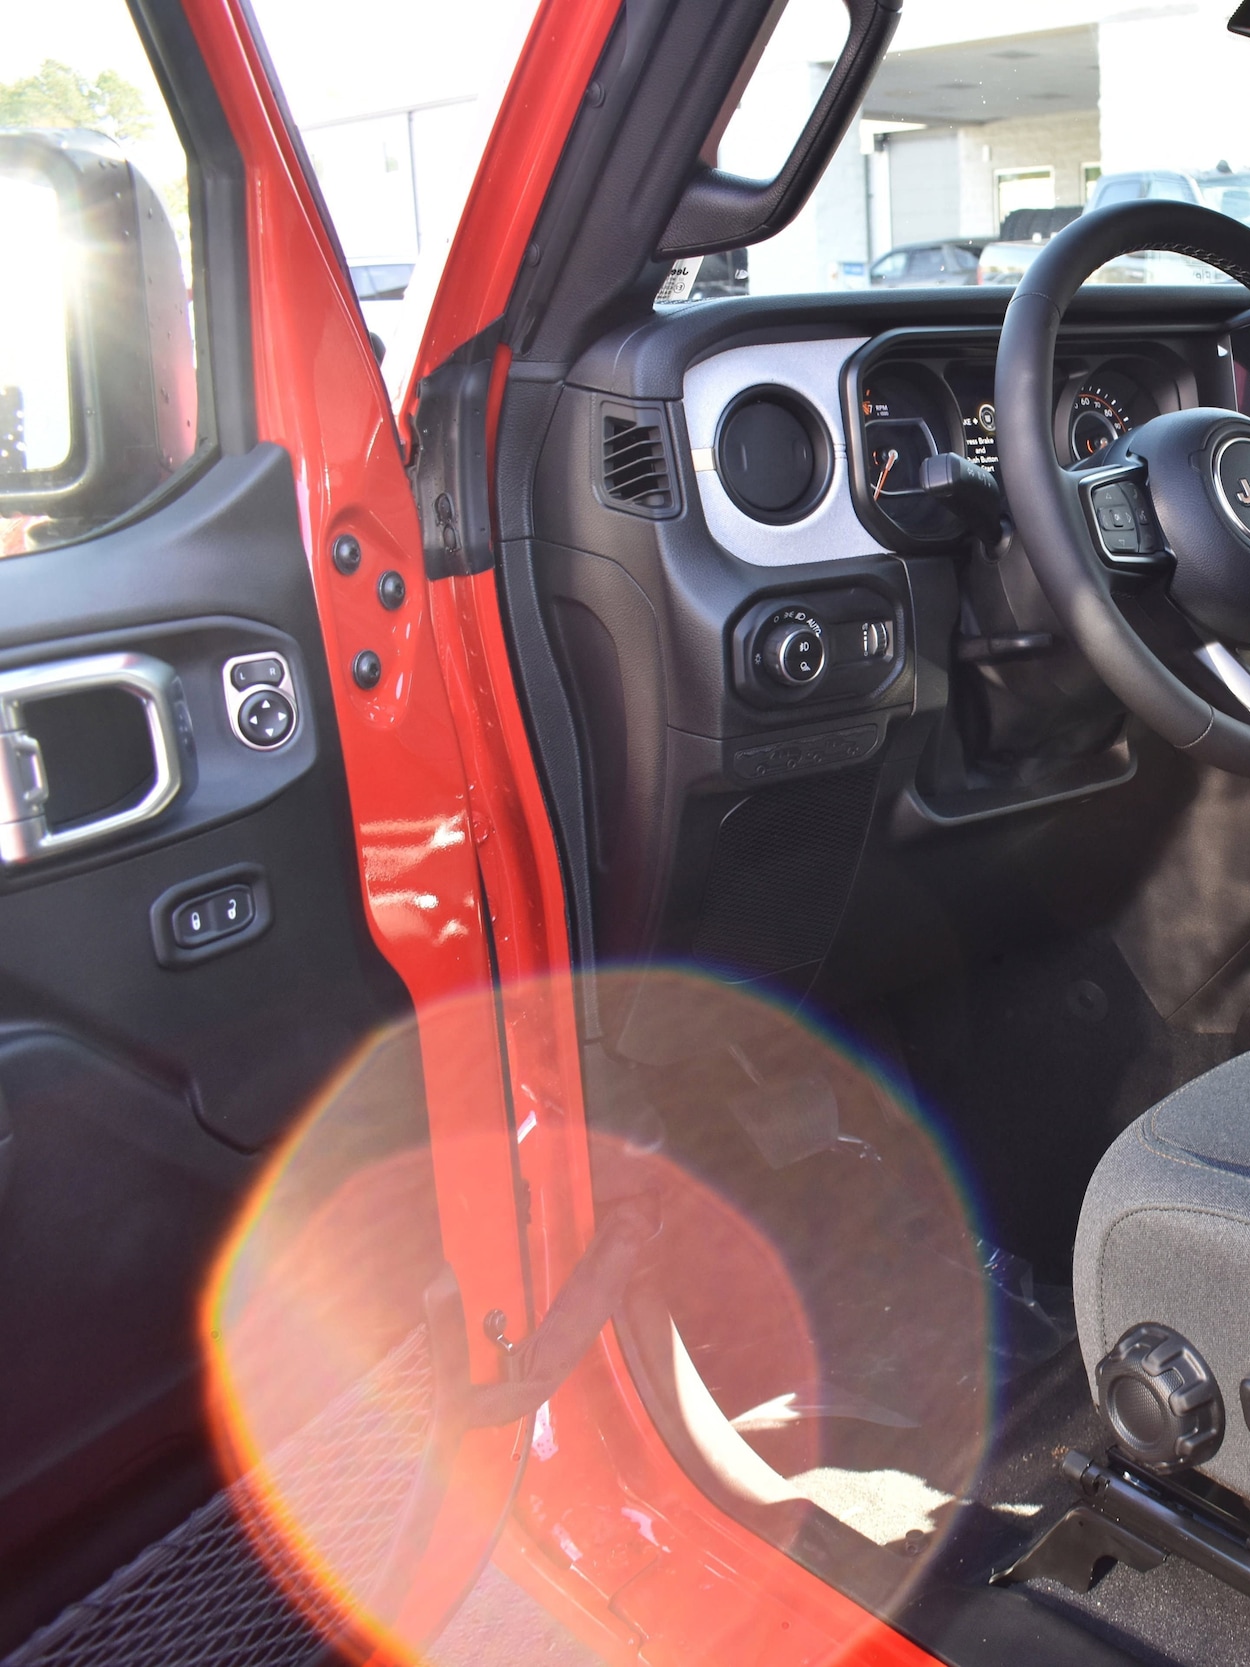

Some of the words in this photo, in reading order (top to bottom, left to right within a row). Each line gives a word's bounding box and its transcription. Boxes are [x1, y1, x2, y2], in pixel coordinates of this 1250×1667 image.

[1080, 397, 1090, 406] 60
[1104, 409, 1113, 418] 80
[978, 437, 994, 446] Brake
[975, 446, 987, 455] and
[980, 456, 999, 464] Button
[806, 618, 822, 636] AUTO
[240, 672, 246, 680] L
[270, 668, 276, 676] R
